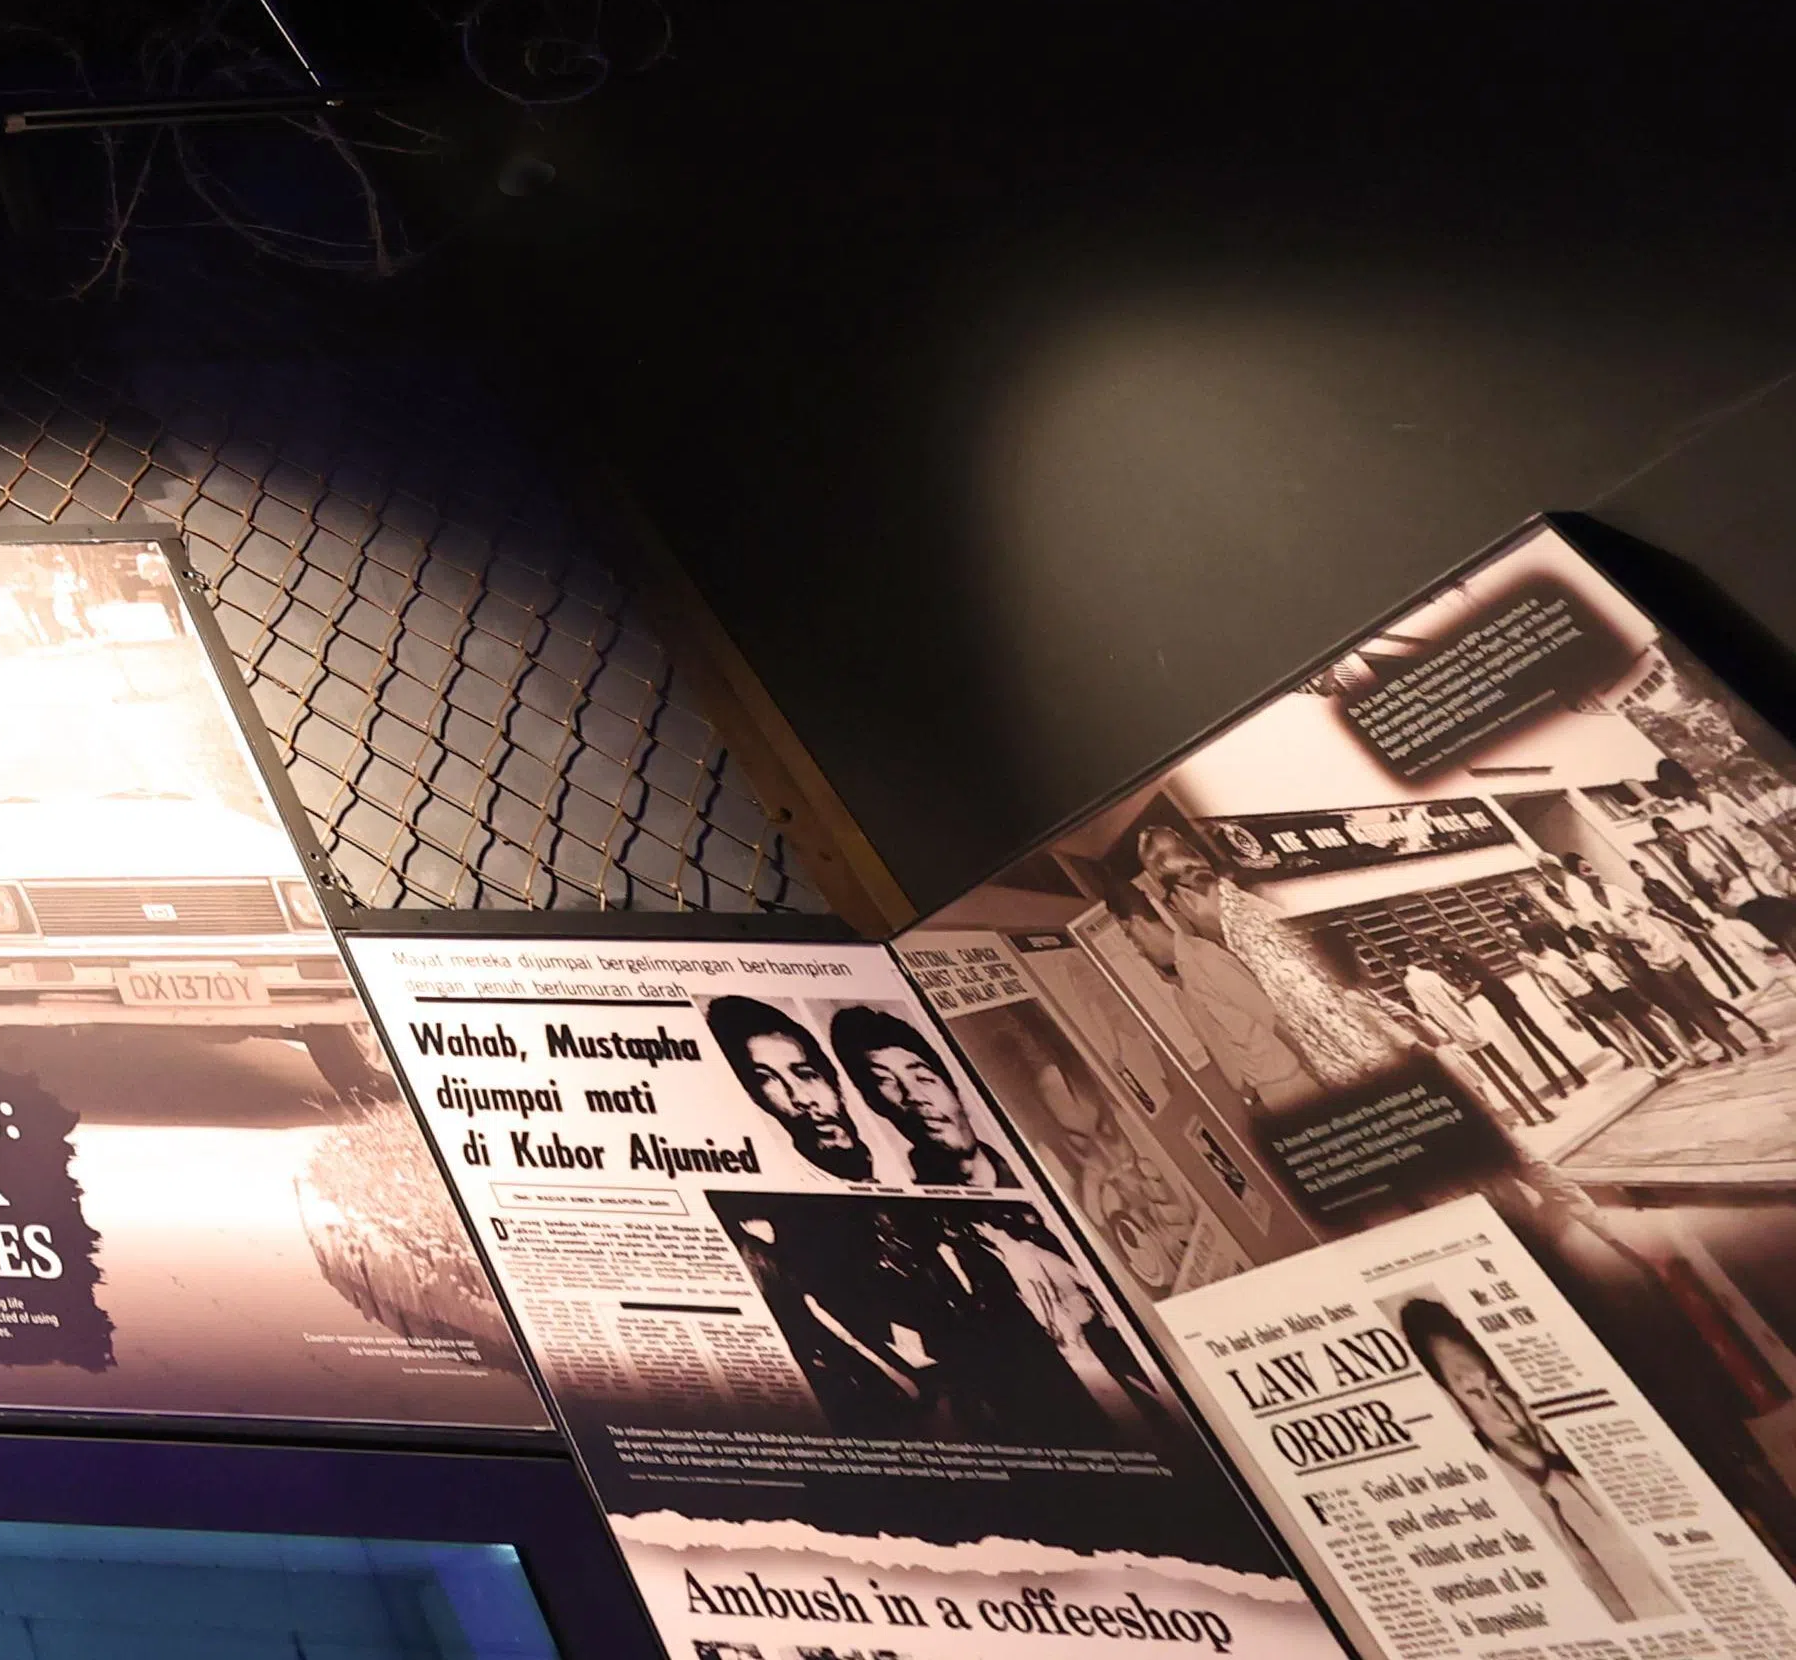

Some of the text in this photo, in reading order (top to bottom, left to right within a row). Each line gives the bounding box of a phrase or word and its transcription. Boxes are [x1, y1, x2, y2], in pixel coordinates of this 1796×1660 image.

[450, 952, 511, 969] mereka
[518, 952, 592, 972] dijumpai
[601, 955, 735, 977] bergelimpangan
[739, 957, 852, 979] berhampiran
[474, 980, 525, 998] penuh
[532, 980, 632, 998] berlumuran
[638, 981, 688, 999] darah
[409, 1021, 702, 1068] Wahab, Mustapha
[436, 1074, 657, 1119] dijumpai mati
[461, 1129, 762, 1179] di Kubor Aljunied
[7, 1297, 24, 1309] life
[19, 1312, 30, 1324] of
[30, 1312, 59, 1328] using
[1226, 1328, 1410, 1411] LAW AND
[683, 1568, 1234, 1654] Ambush in a coffeeshop
